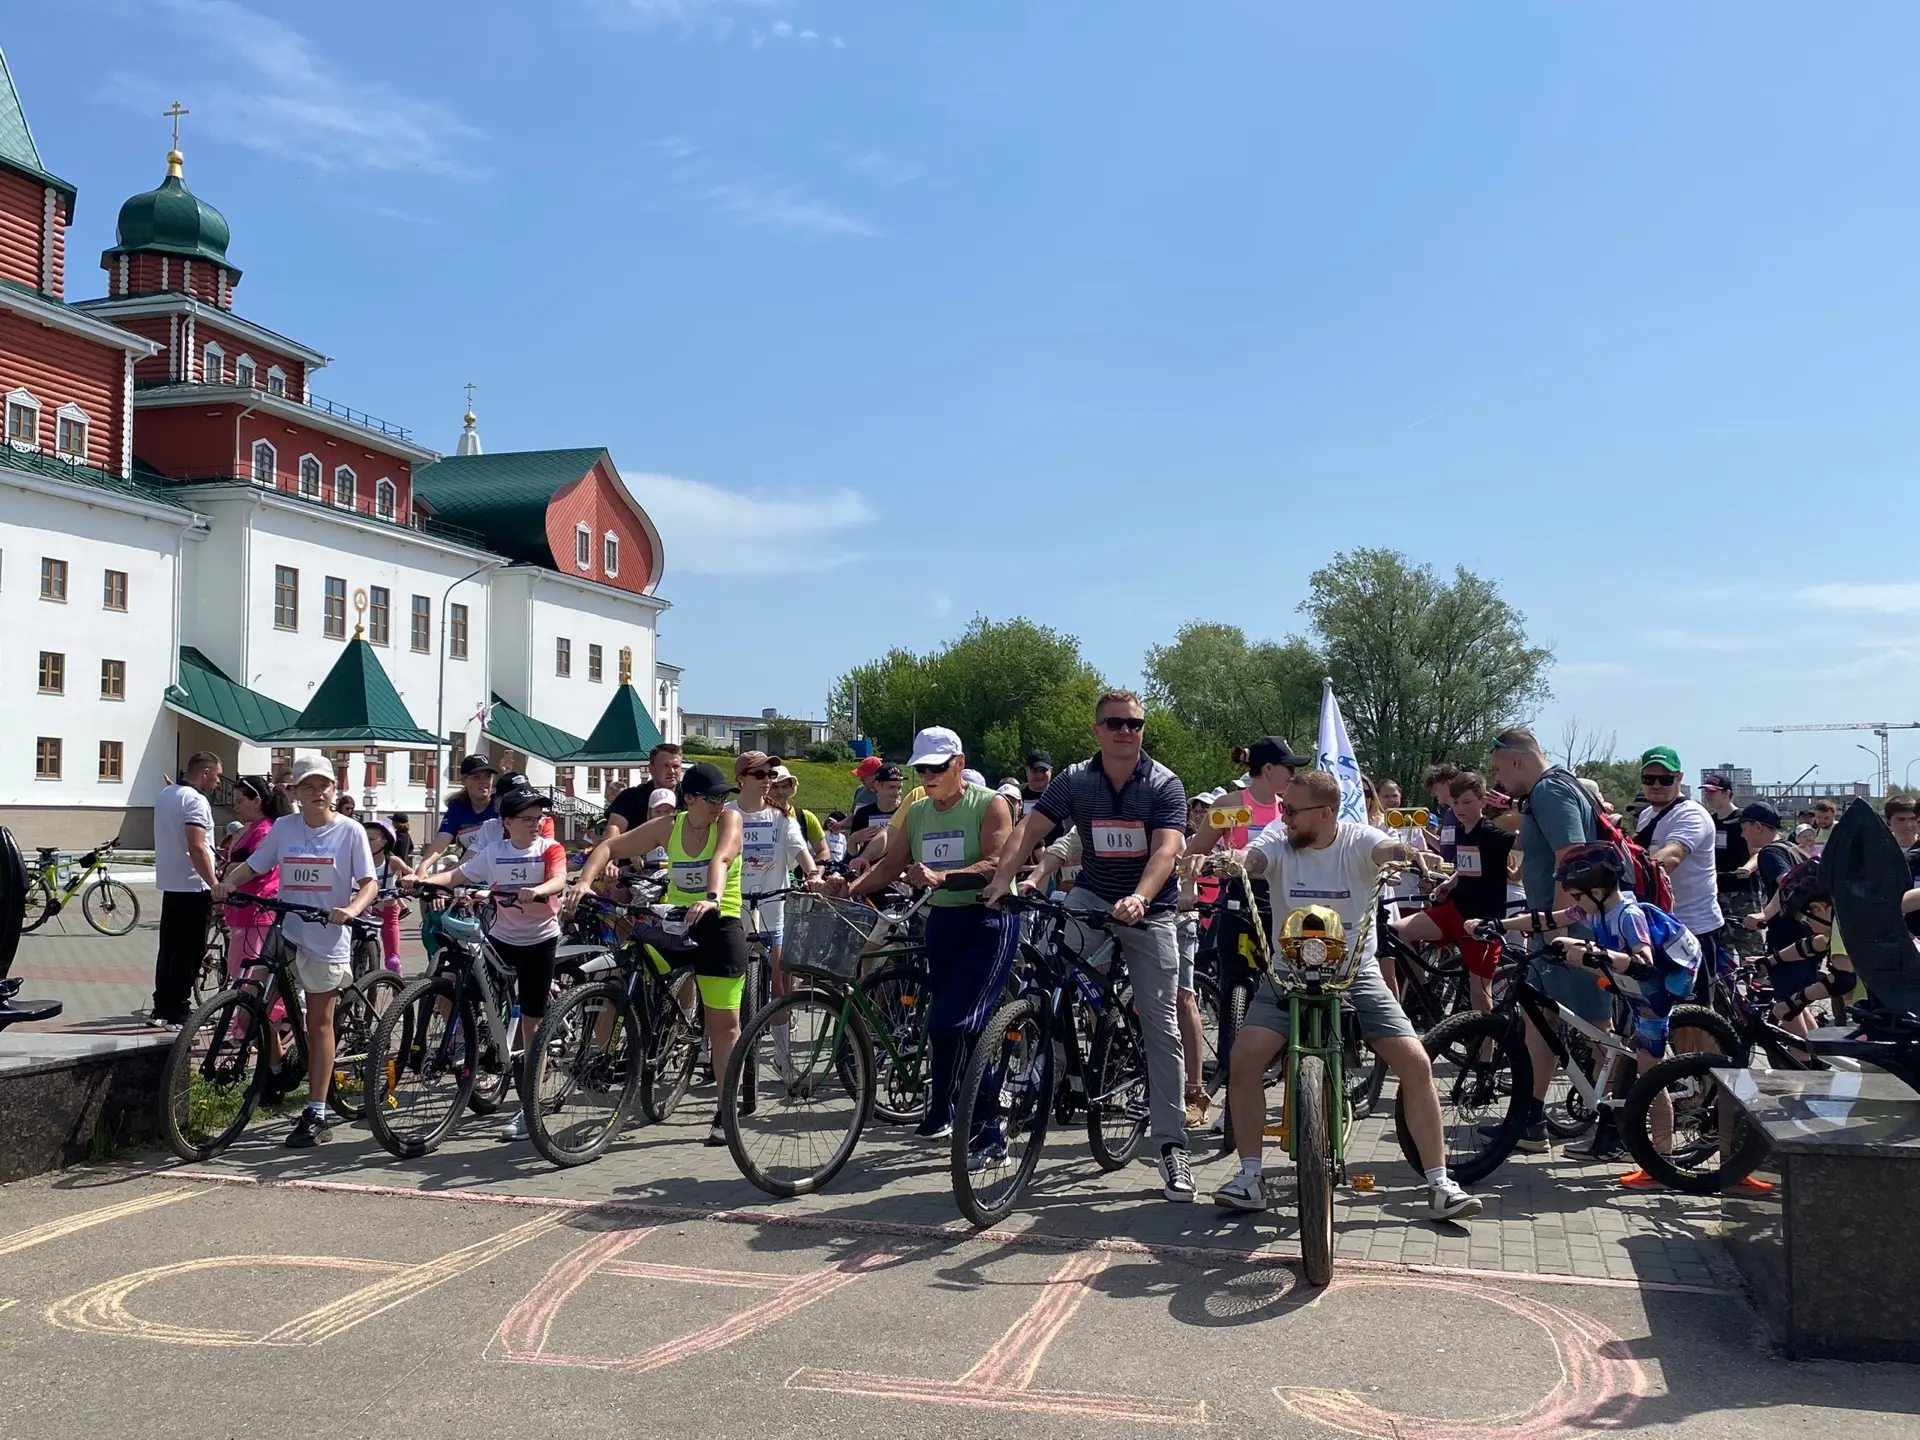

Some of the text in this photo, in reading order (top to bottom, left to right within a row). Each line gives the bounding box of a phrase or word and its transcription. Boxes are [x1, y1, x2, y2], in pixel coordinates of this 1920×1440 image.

[744, 831, 759, 842] 98
[1107, 833, 1133, 848] 018
[934, 844, 949, 858] 67
[294, 868, 320, 883] 005
[511, 868, 528, 881] 54
[686, 872, 703, 885] 55
